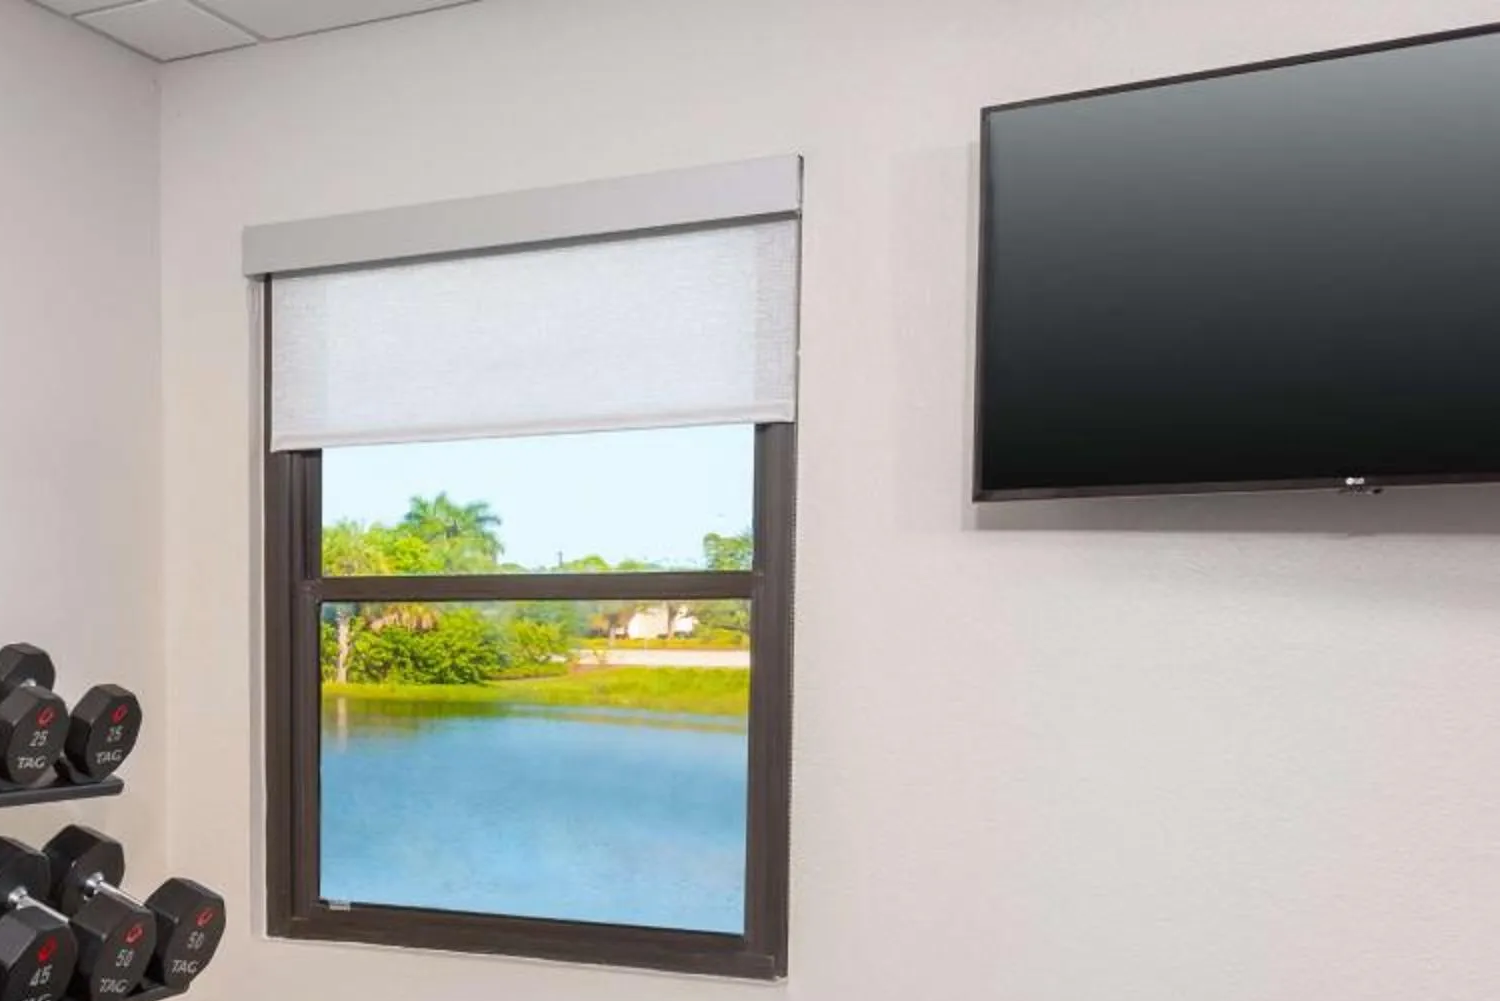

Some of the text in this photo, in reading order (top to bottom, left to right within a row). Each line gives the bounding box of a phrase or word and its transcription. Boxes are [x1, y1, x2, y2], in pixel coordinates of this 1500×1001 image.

[29, 730, 49, 747] 25
[17, 755, 46, 769] TAG
[95, 749, 123, 765] TAG
[171, 959, 199, 974] TAG
[29, 964, 53, 987] 45
[99, 977, 128, 994] TAG
